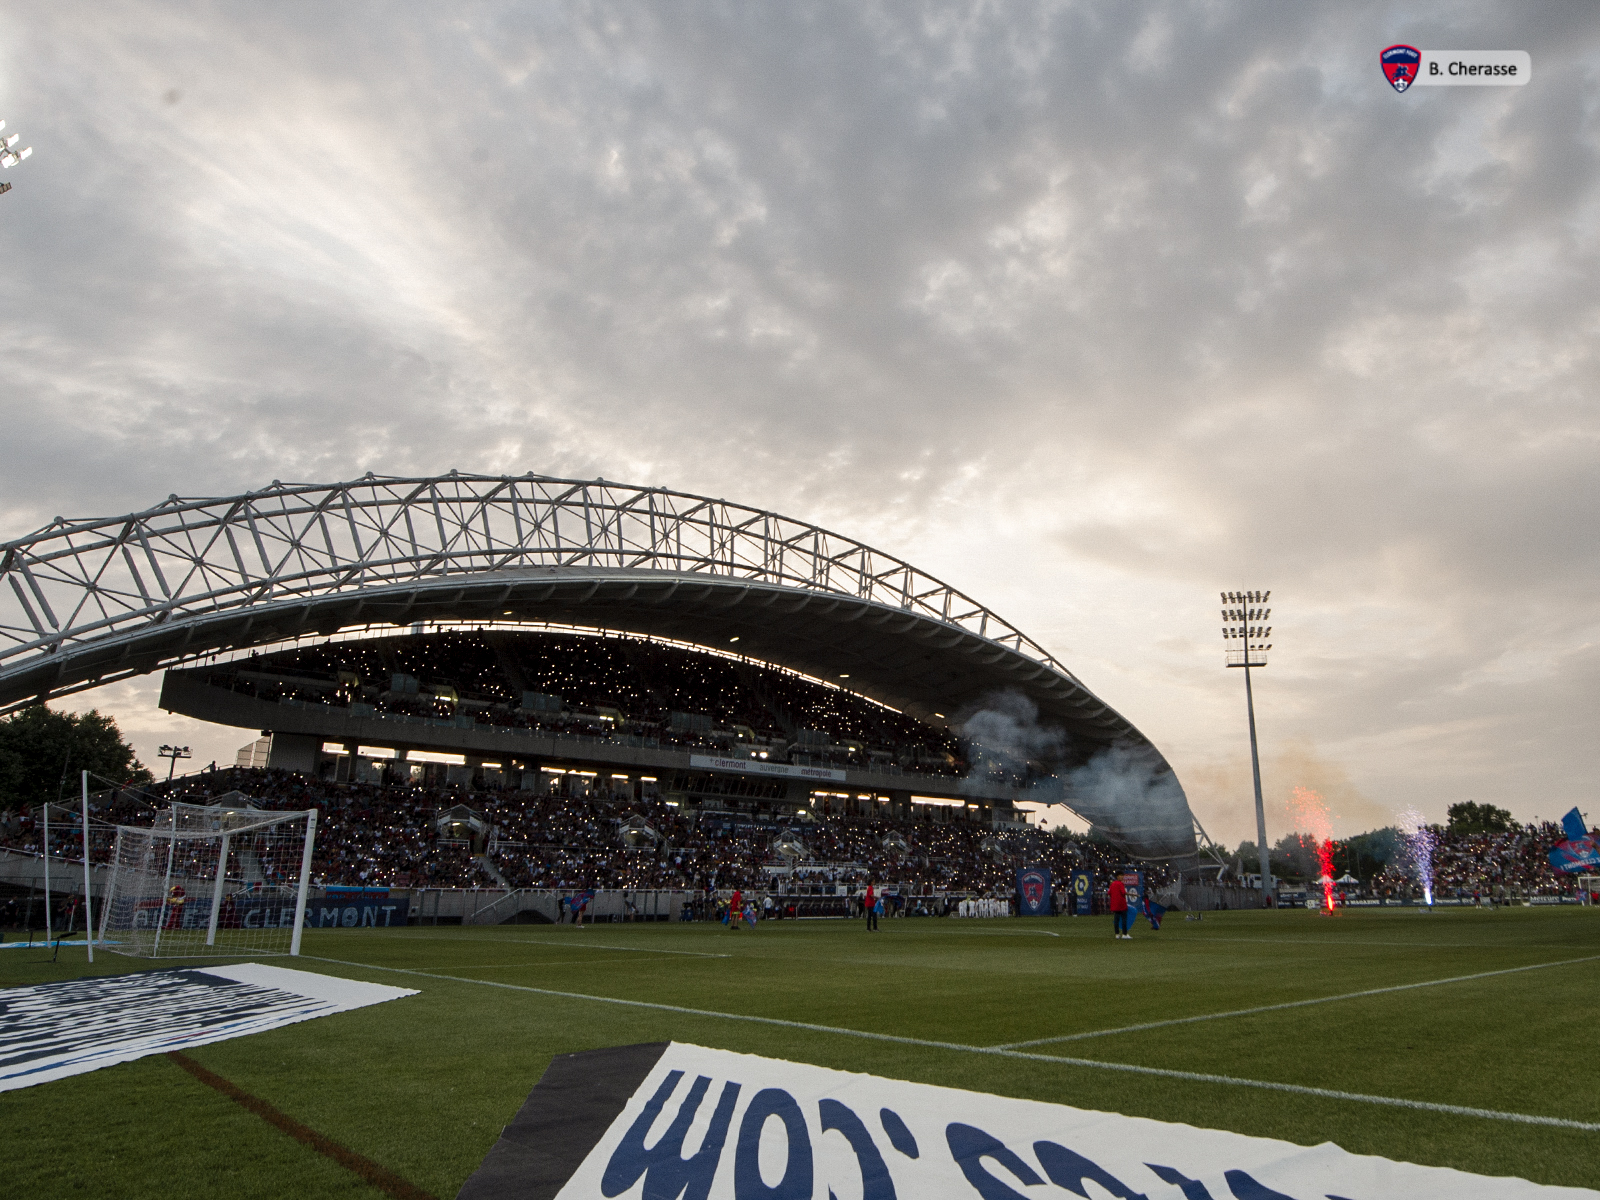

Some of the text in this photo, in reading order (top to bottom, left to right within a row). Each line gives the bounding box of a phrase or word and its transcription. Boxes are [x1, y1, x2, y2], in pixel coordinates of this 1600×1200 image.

[714, 758, 831, 778] clermont auvergne métropole
[243, 905, 397, 928] CLERMONT
